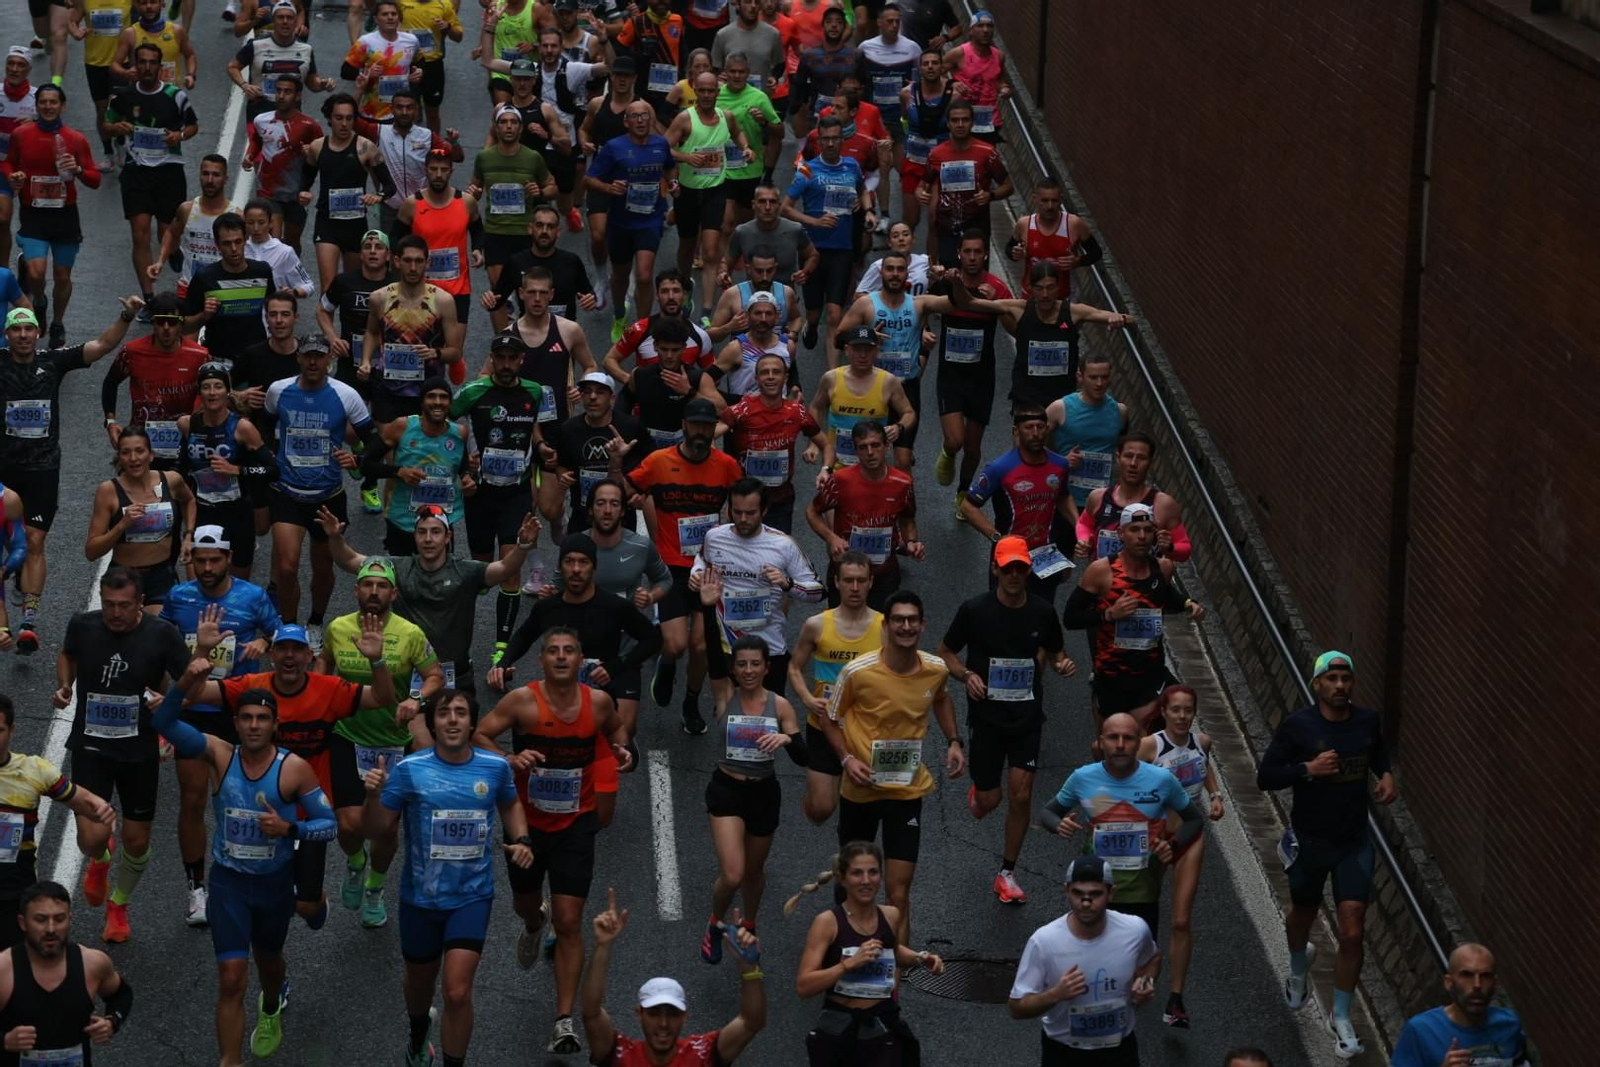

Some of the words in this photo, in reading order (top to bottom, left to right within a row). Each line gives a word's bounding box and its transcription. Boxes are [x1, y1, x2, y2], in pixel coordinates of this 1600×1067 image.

[389, 352, 416, 365] 2276
[12, 410, 42, 421] 3399
[838, 406, 865, 415] WEST
[151, 430, 180, 443] 2632
[753, 460, 779, 471] 1710
[421, 487, 446, 499] 1722
[857, 535, 883, 547] 1712
[731, 600, 759, 613] 2562
[829, 651, 859, 660] WEST
[997, 669, 1026, 682] 1761
[94, 705, 127, 719] 1898
[879, 751, 908, 765] 8256
[537, 779, 570, 794] 3082
[441, 822, 475, 838] 1957
[1102, 834, 1135, 848] 3187
[1079, 1014, 1115, 1031] 3389
